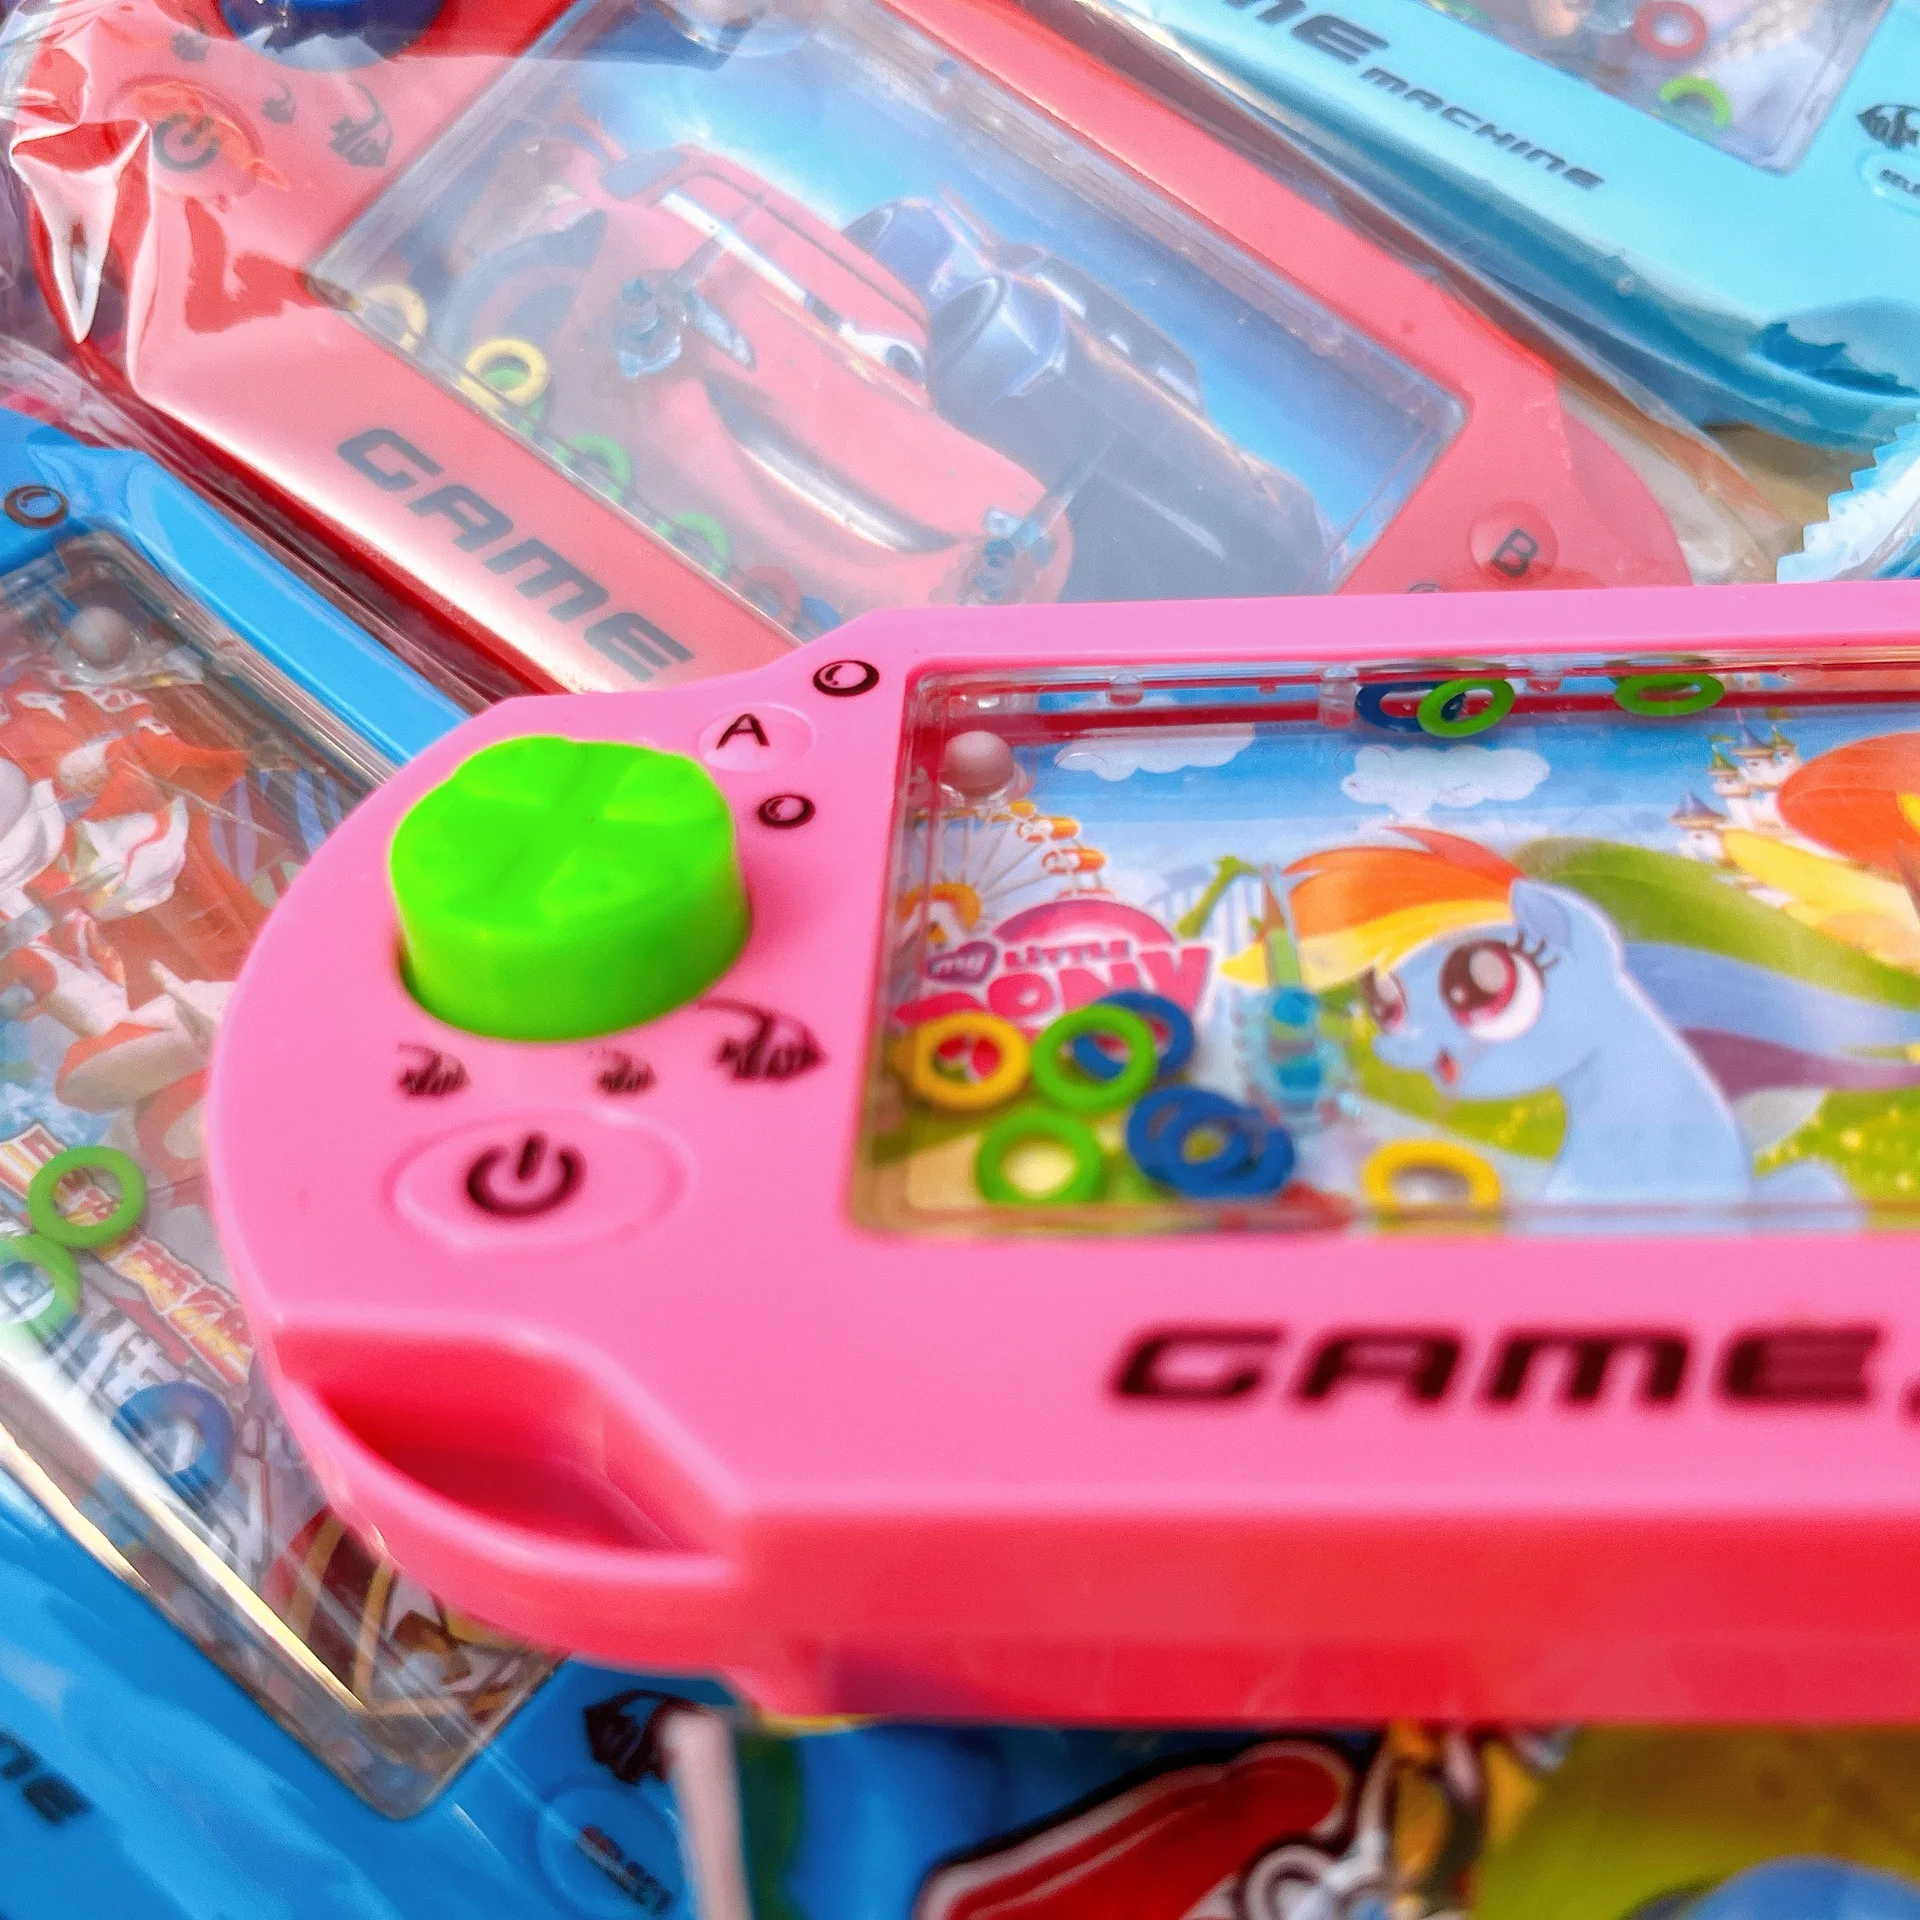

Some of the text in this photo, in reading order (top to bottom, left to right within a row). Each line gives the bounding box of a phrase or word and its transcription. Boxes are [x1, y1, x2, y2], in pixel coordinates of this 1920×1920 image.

[1359, 66, 1605, 191] MACHINE
[337, 428, 696, 683] GAME
[1491, 528, 1538, 577] B
[716, 713, 769, 750] A
[1110, 1323, 1881, 1406] GAME
